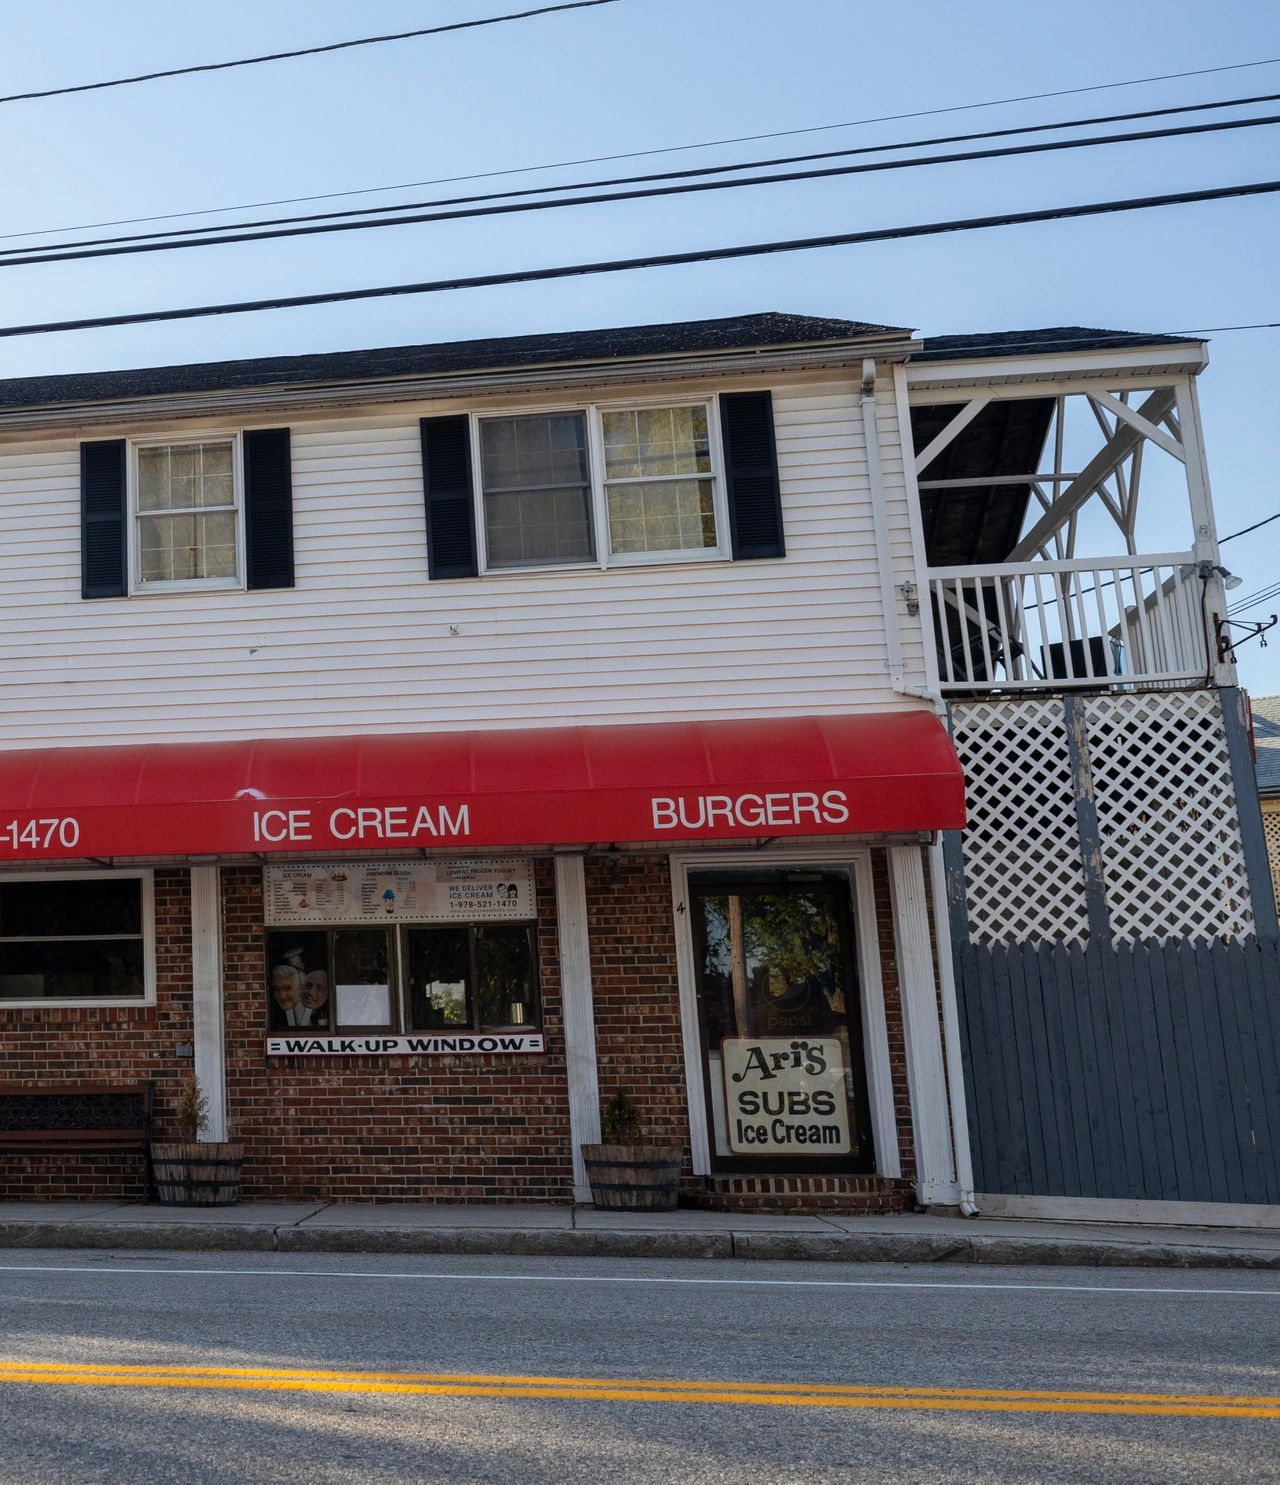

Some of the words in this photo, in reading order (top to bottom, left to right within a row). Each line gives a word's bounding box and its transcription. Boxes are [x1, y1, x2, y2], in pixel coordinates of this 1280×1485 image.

[651, 790, 849, 829] BURGERS
[253, 810, 312, 842] ICE
[329, 804, 471, 839] CREAM
[446, 868, 469, 876] LOWFAT
[462, 884, 493, 892] DELIVER
[464, 891, 494, 899] CREAM
[450, 899, 517, 908] 1-978-521-1470
[676, 901, 686, 915] 4
[285, 1039, 399, 1053] WALK-UP
[407, 1037, 525, 1052] WINDOW
[731, 1041, 827, 1083] Ari's
[738, 1090, 836, 1116] SUBS
[736, 1118, 768, 1145] Ice
[771, 1118, 841, 1145] Cream
